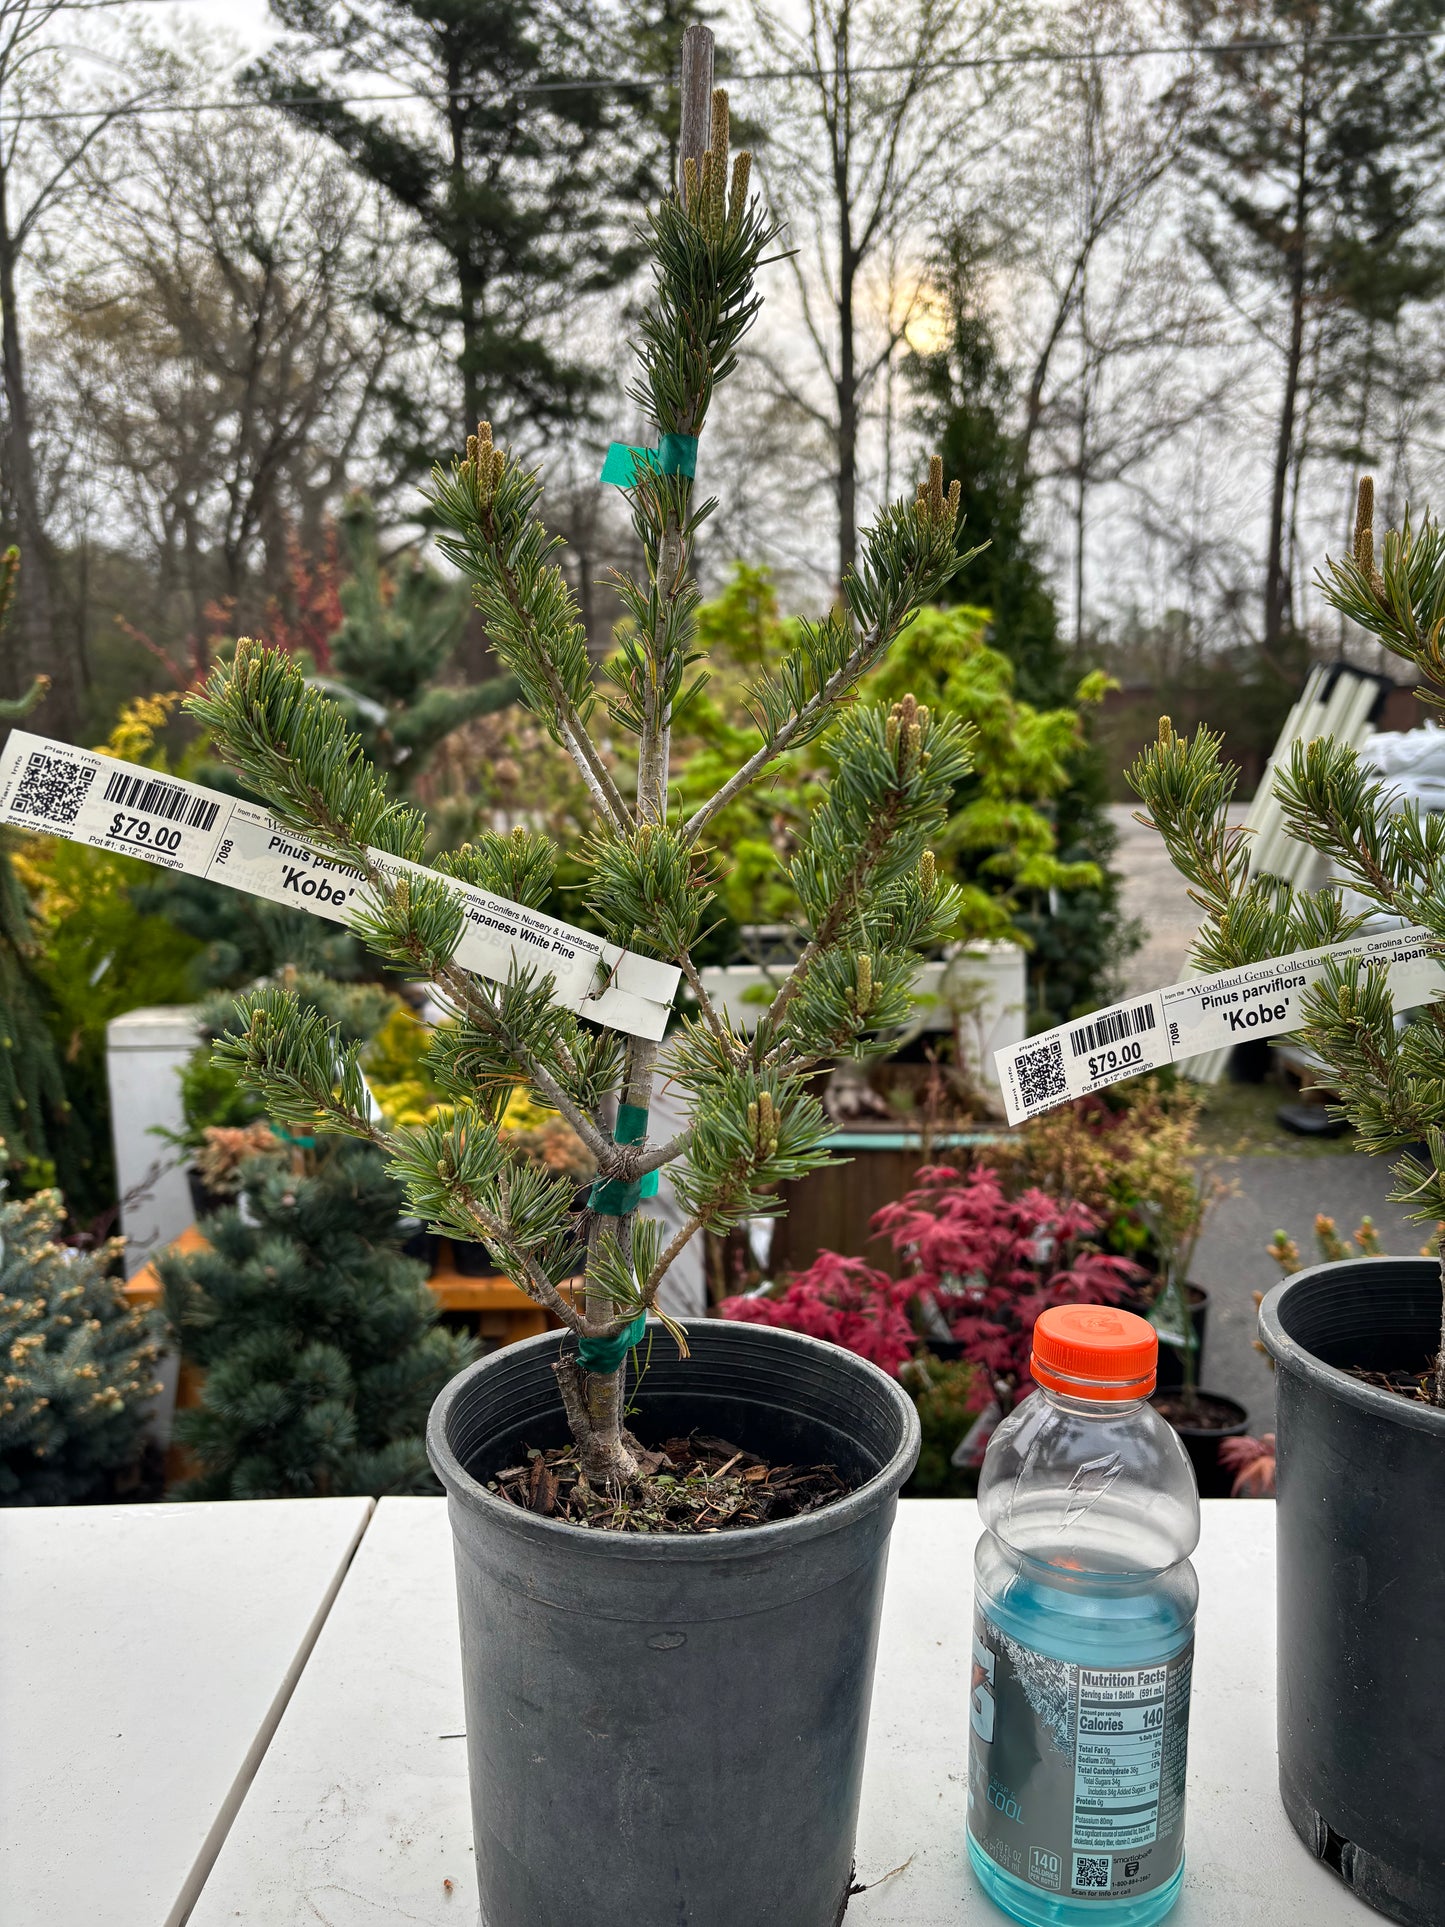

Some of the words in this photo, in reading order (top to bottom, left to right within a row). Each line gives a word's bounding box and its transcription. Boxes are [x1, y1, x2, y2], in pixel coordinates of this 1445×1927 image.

[11, 755, 23, 775] Info
[44, 745, 74, 758] Plant
[80, 756, 102, 766] Info
[237, 806, 251, 818] from
[251, 812, 261, 821] the
[7, 814, 28, 824] Scan
[42, 822, 54, 830] for
[54, 827, 74, 835] more
[110, 812, 182, 850] $79.00
[88, 835, 103, 846] Pot
[144, 852, 155, 860] on
[156, 855, 184, 869] mugho
[216, 839, 234, 865] 7088
[267, 836, 311, 862] Pinus
[282, 865, 356, 906] 'Kobe'
[465, 907, 518, 936] Japanese
[519, 928, 550, 950] White
[551, 940, 576, 960] Pine
[487, 901, 520, 920] Conifers
[521, 914, 552, 934] Nursery
[553, 928, 560, 936] &
[560, 930, 600, 952] Landscape
[1331, 950, 1352, 958] Grown
[1367, 938, 1402, 952] Carolina
[1164, 992, 1176, 1000] from
[1187, 974, 1242, 996] "Woodland
[1244, 968, 1274, 983] Gems
[1200, 992, 1240, 1010] Pinus
[1242, 975, 1307, 1000] parviflora
[1222, 998, 1290, 1032] 'Kobe'
[1019, 1040, 1040, 1052] Plant
[1044, 1033, 1060, 1042] Info
[1169, 1022, 1180, 1046] 7088
[1088, 1042, 1142, 1076] $79.00
[1082, 1084, 1093, 1093] Pot
[1132, 1062, 1154, 1074] mugho
[1082, 1671, 1134, 1687] Nutrition
[1138, 1669, 1166, 1686] Facts
[1068, 1683, 1077, 1700] FRUIT
[1081, 1688, 1101, 1700] Serving
[1102, 1690, 1114, 1700] size
[1114, 1690, 1118, 1699] 1
[1120, 1690, 1134, 1700] Bottle
[1140, 1688, 1152, 1700] (591
[1154, 1685, 1164, 1696] mL)
[1068, 1701, 1076, 1710] NO
[1080, 1708, 1096, 1716] Amount
[1067, 1712, 1076, 1740] CONTAINS
[1080, 1716, 1124, 1731] Calories
[1142, 1707, 1163, 1728] 140
[1078, 1745, 1093, 1753] Total
[1094, 1746, 1104, 1754] Fat
[1104, 1747, 1110, 1755] 0g
[1078, 1756, 1100, 1764] Sodium
[1100, 1757, 1116, 1766] 270mg
[1078, 1766, 1092, 1774] Total
[1093, 1767, 1130, 1776] Carbohydrate
[1084, 1776, 1094, 1785] Total
[1095, 1778, 1111, 1786] Sugars
[1112, 1778, 1120, 1787] 34g
[1088, 1787, 1107, 1796] Includes
[1108, 1788, 1116, 1796] 34g
[1117, 1787, 1132, 1796] Added
[1132, 1786, 1146, 1794] Sugars
[986, 1784, 1024, 1824] COOL
[1076, 1796, 1096, 1805] Protein
[1075, 1816, 1099, 1824] Potassium
[1100, 1818, 1114, 1826] 80mg
[1084, 1830, 1102, 1838] significant
[1033, 1850, 1058, 1872] 140
[1030, 1866, 1058, 1880] CALORIES
[1030, 1872, 1040, 1880] PER
[1040, 1876, 1058, 1888] BOTTLE
[1072, 1888, 1086, 1896] Scan
